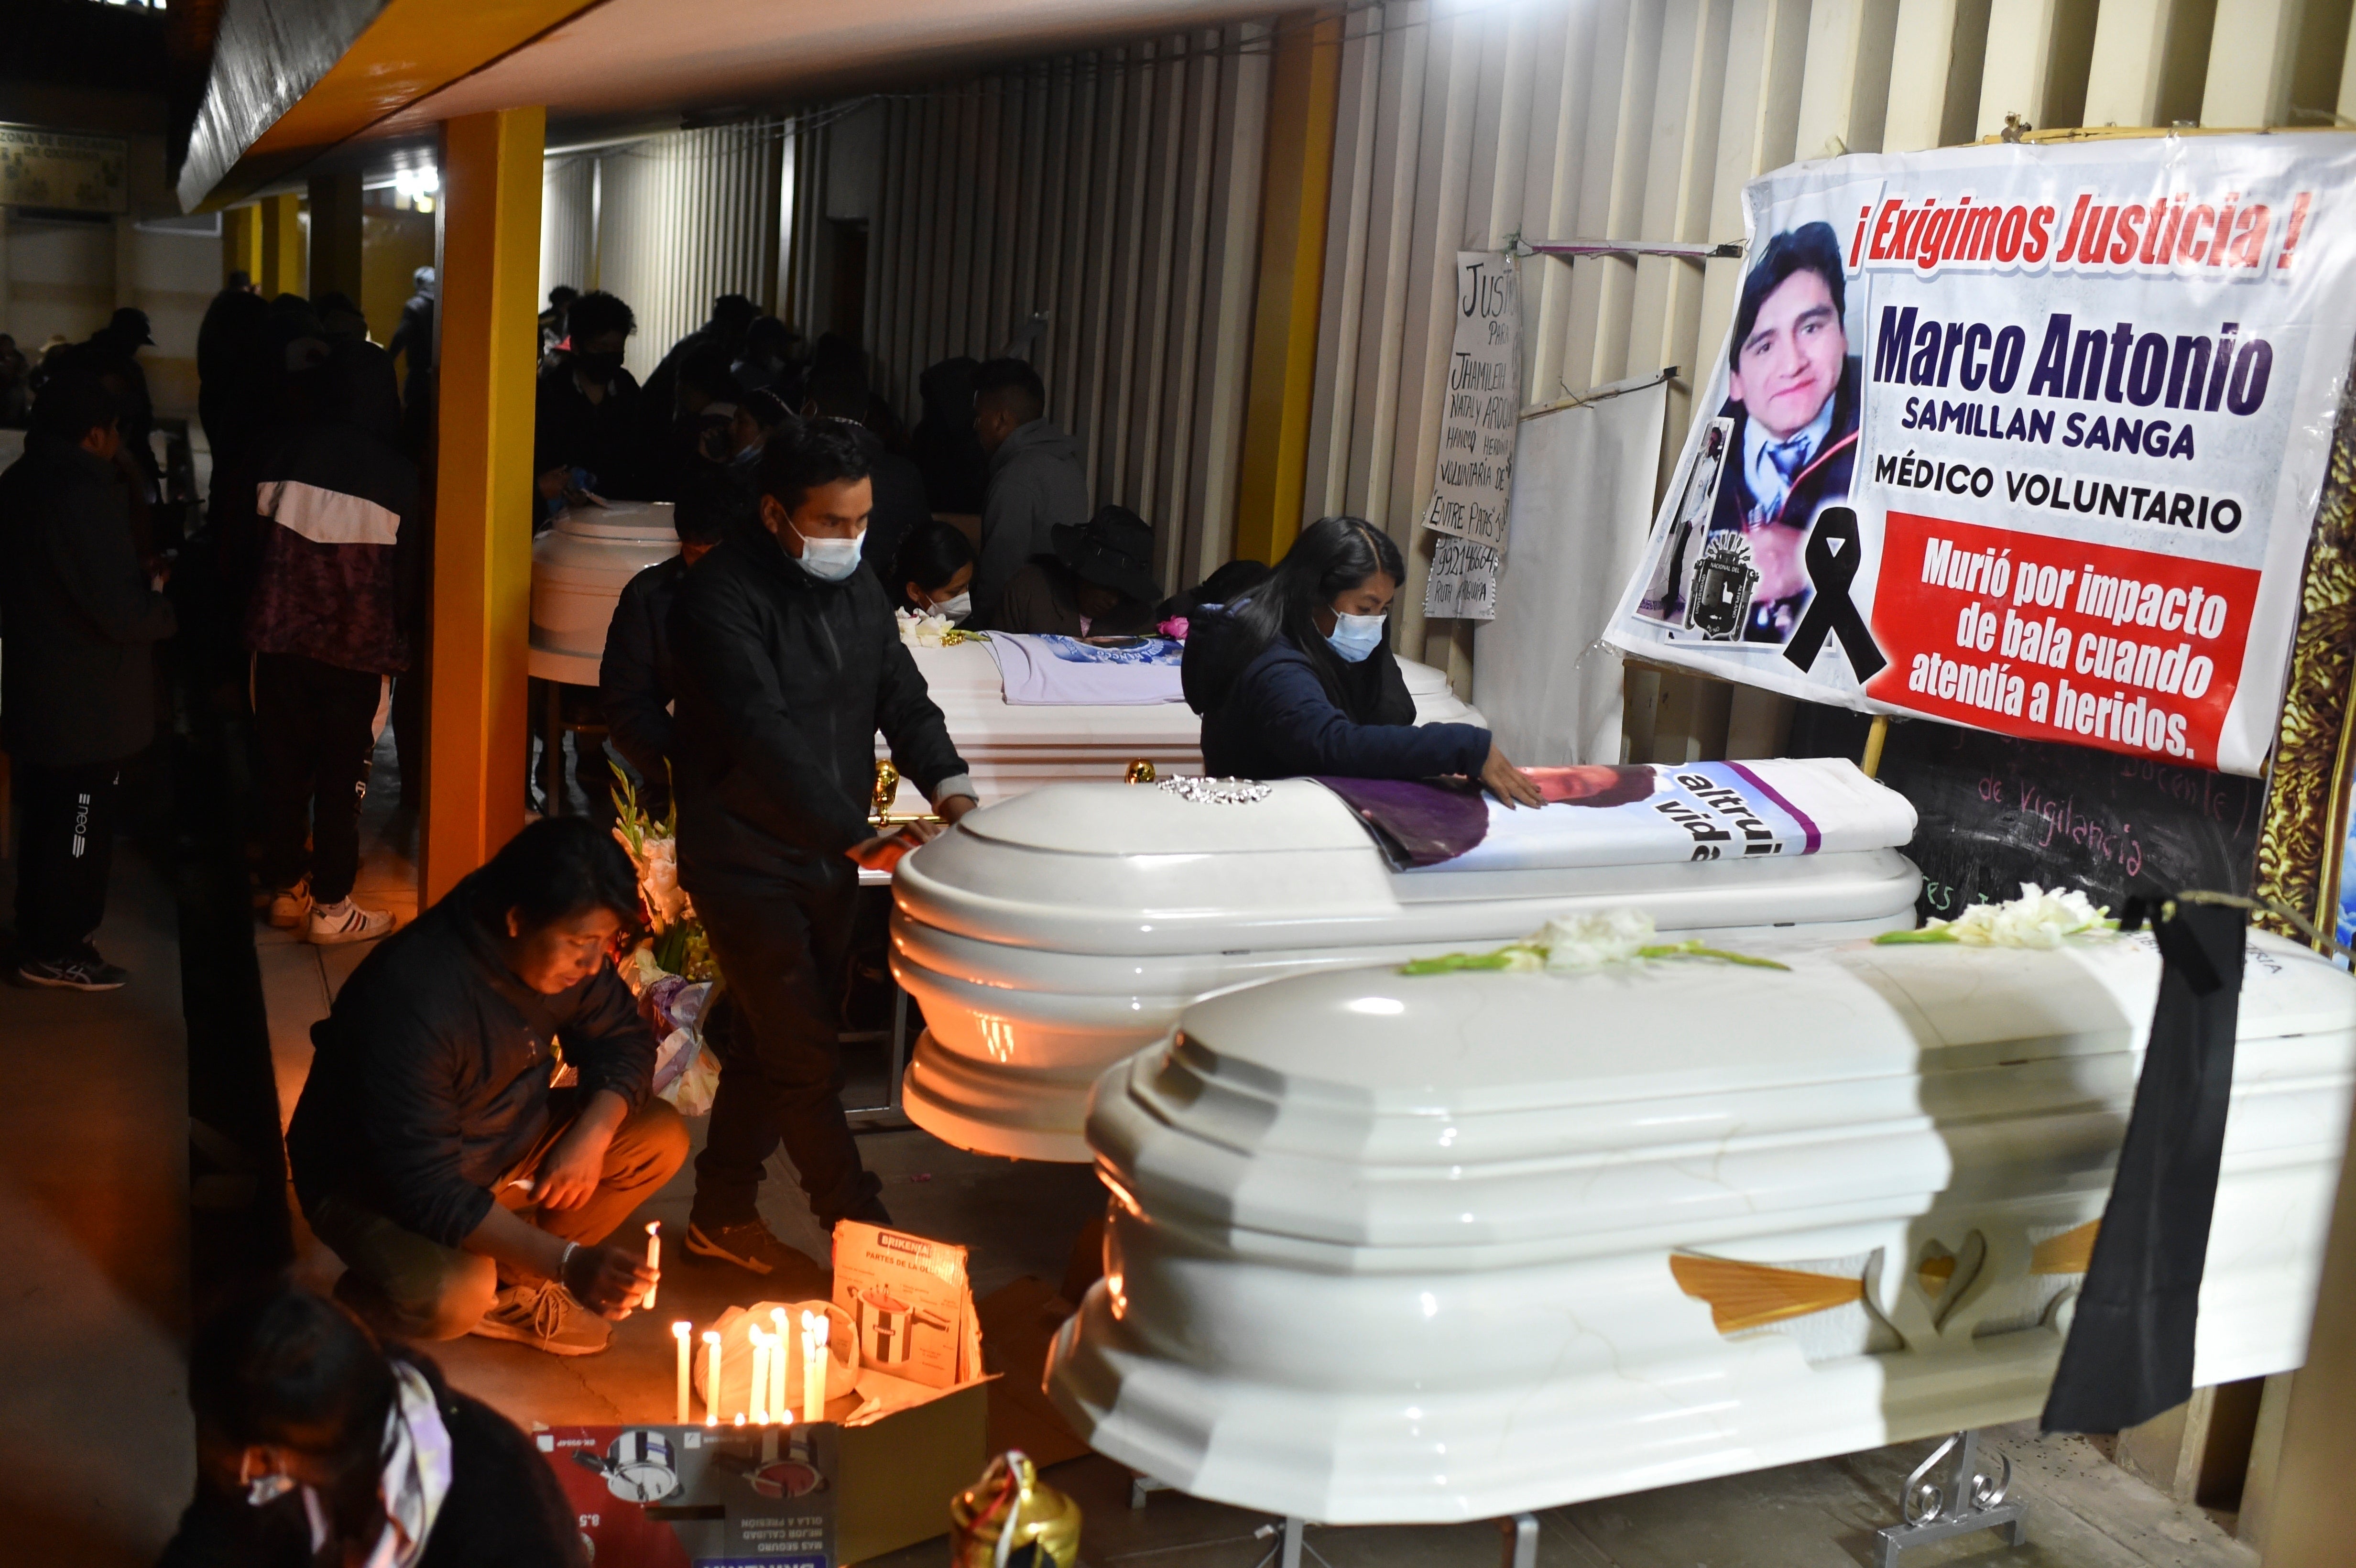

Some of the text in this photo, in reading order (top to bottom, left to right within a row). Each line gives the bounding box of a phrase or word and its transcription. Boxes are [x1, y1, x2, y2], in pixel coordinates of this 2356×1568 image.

[1873, 306, 2273, 416] Marco Antonio
[1450, 393, 1482, 426] NATALY
[1901, 396, 2194, 460] SAMILLAN SANGA
[1875, 449, 2242, 534] MÉDICO VOLUNTARIO
[1434, 580, 1452, 603] RUTH
[1921, 537, 2227, 639] Murió por impacto
[1956, 601, 2214, 699] de bala cuando
[1909, 652, 2025, 718] atendía
[2029, 682, 2050, 724] a
[2054, 678, 2195, 760] heridos.
[1978, 773, 2002, 803] de
[75, 805, 89, 834] neo
[866, 1251, 894, 1264] PARTES
[896, 1259, 906, 1267] DE
[908, 1262, 917, 1271] LA
[579, 1514, 600, 1527] 8.5
